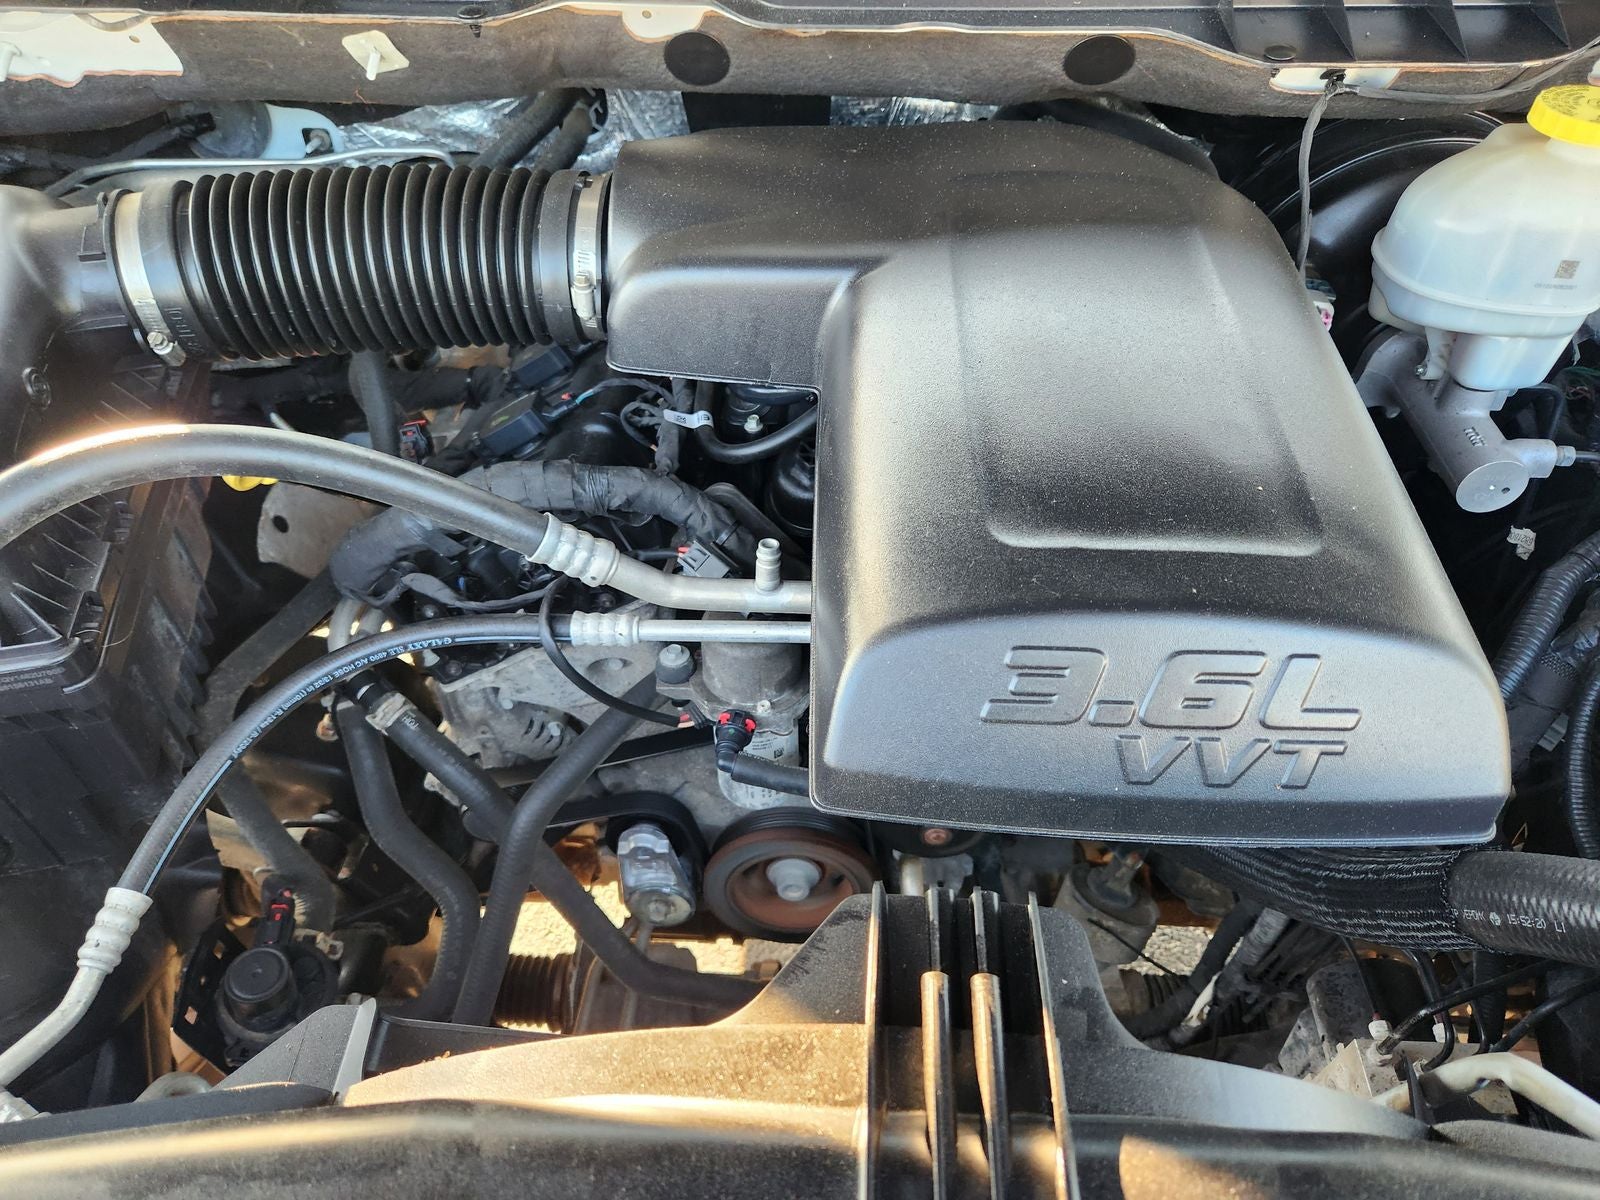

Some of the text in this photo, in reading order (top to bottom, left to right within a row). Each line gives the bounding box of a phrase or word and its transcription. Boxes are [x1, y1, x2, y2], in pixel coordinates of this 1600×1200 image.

[407, 637, 452, 651] GALAXY
[355, 656, 368, 667] A/C
[333, 663, 355, 678] HOSE
[980, 644, 1362, 731] 3.6L
[1116, 734, 1348, 790] VVT
[1507, 914, 1546, 929] 15:52:20
